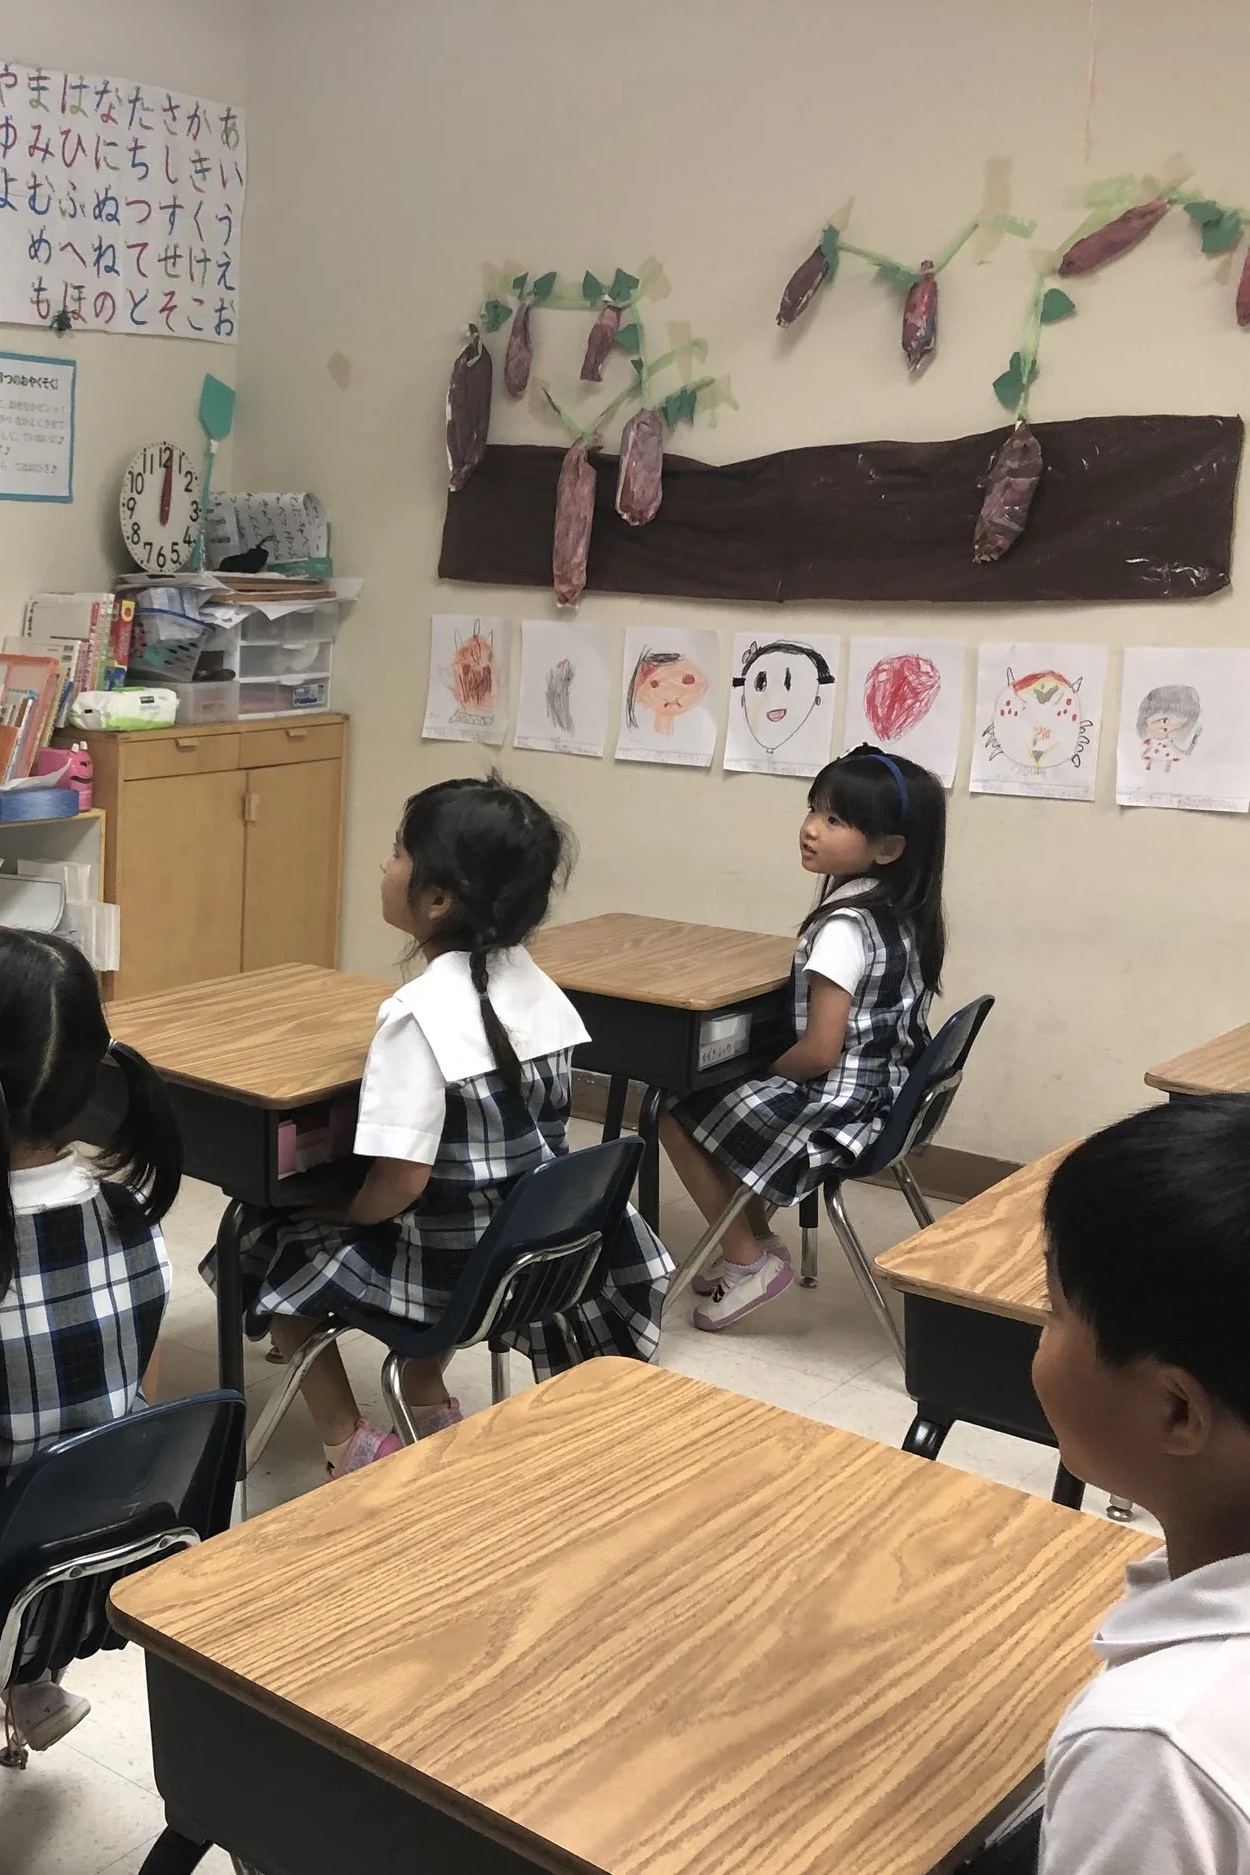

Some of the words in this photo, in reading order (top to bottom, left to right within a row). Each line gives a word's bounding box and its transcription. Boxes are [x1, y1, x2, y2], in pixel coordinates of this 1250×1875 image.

[27, 67, 55, 320] まみむめも
[92, 79, 122, 324] なにぬねの
[125, 86, 155, 326] たちつてと
[158, 94, 184, 332] さしすせそ
[187, 102, 212, 331] かきくけこ
[214, 107, 243, 336] あいうえお
[143, 453, 154, 475] 11
[159, 446, 173, 469] 12
[130, 472, 144, 495] 10
[184, 470, 193, 493] 2
[126, 497, 136, 519] 9
[190, 500, 199, 522] 3
[131, 522, 141, 545] 8
[183, 525, 193, 547] 4
[143, 542, 153, 563] 7
[156, 545, 166, 568] 6
[170, 542, 180, 564] 5
